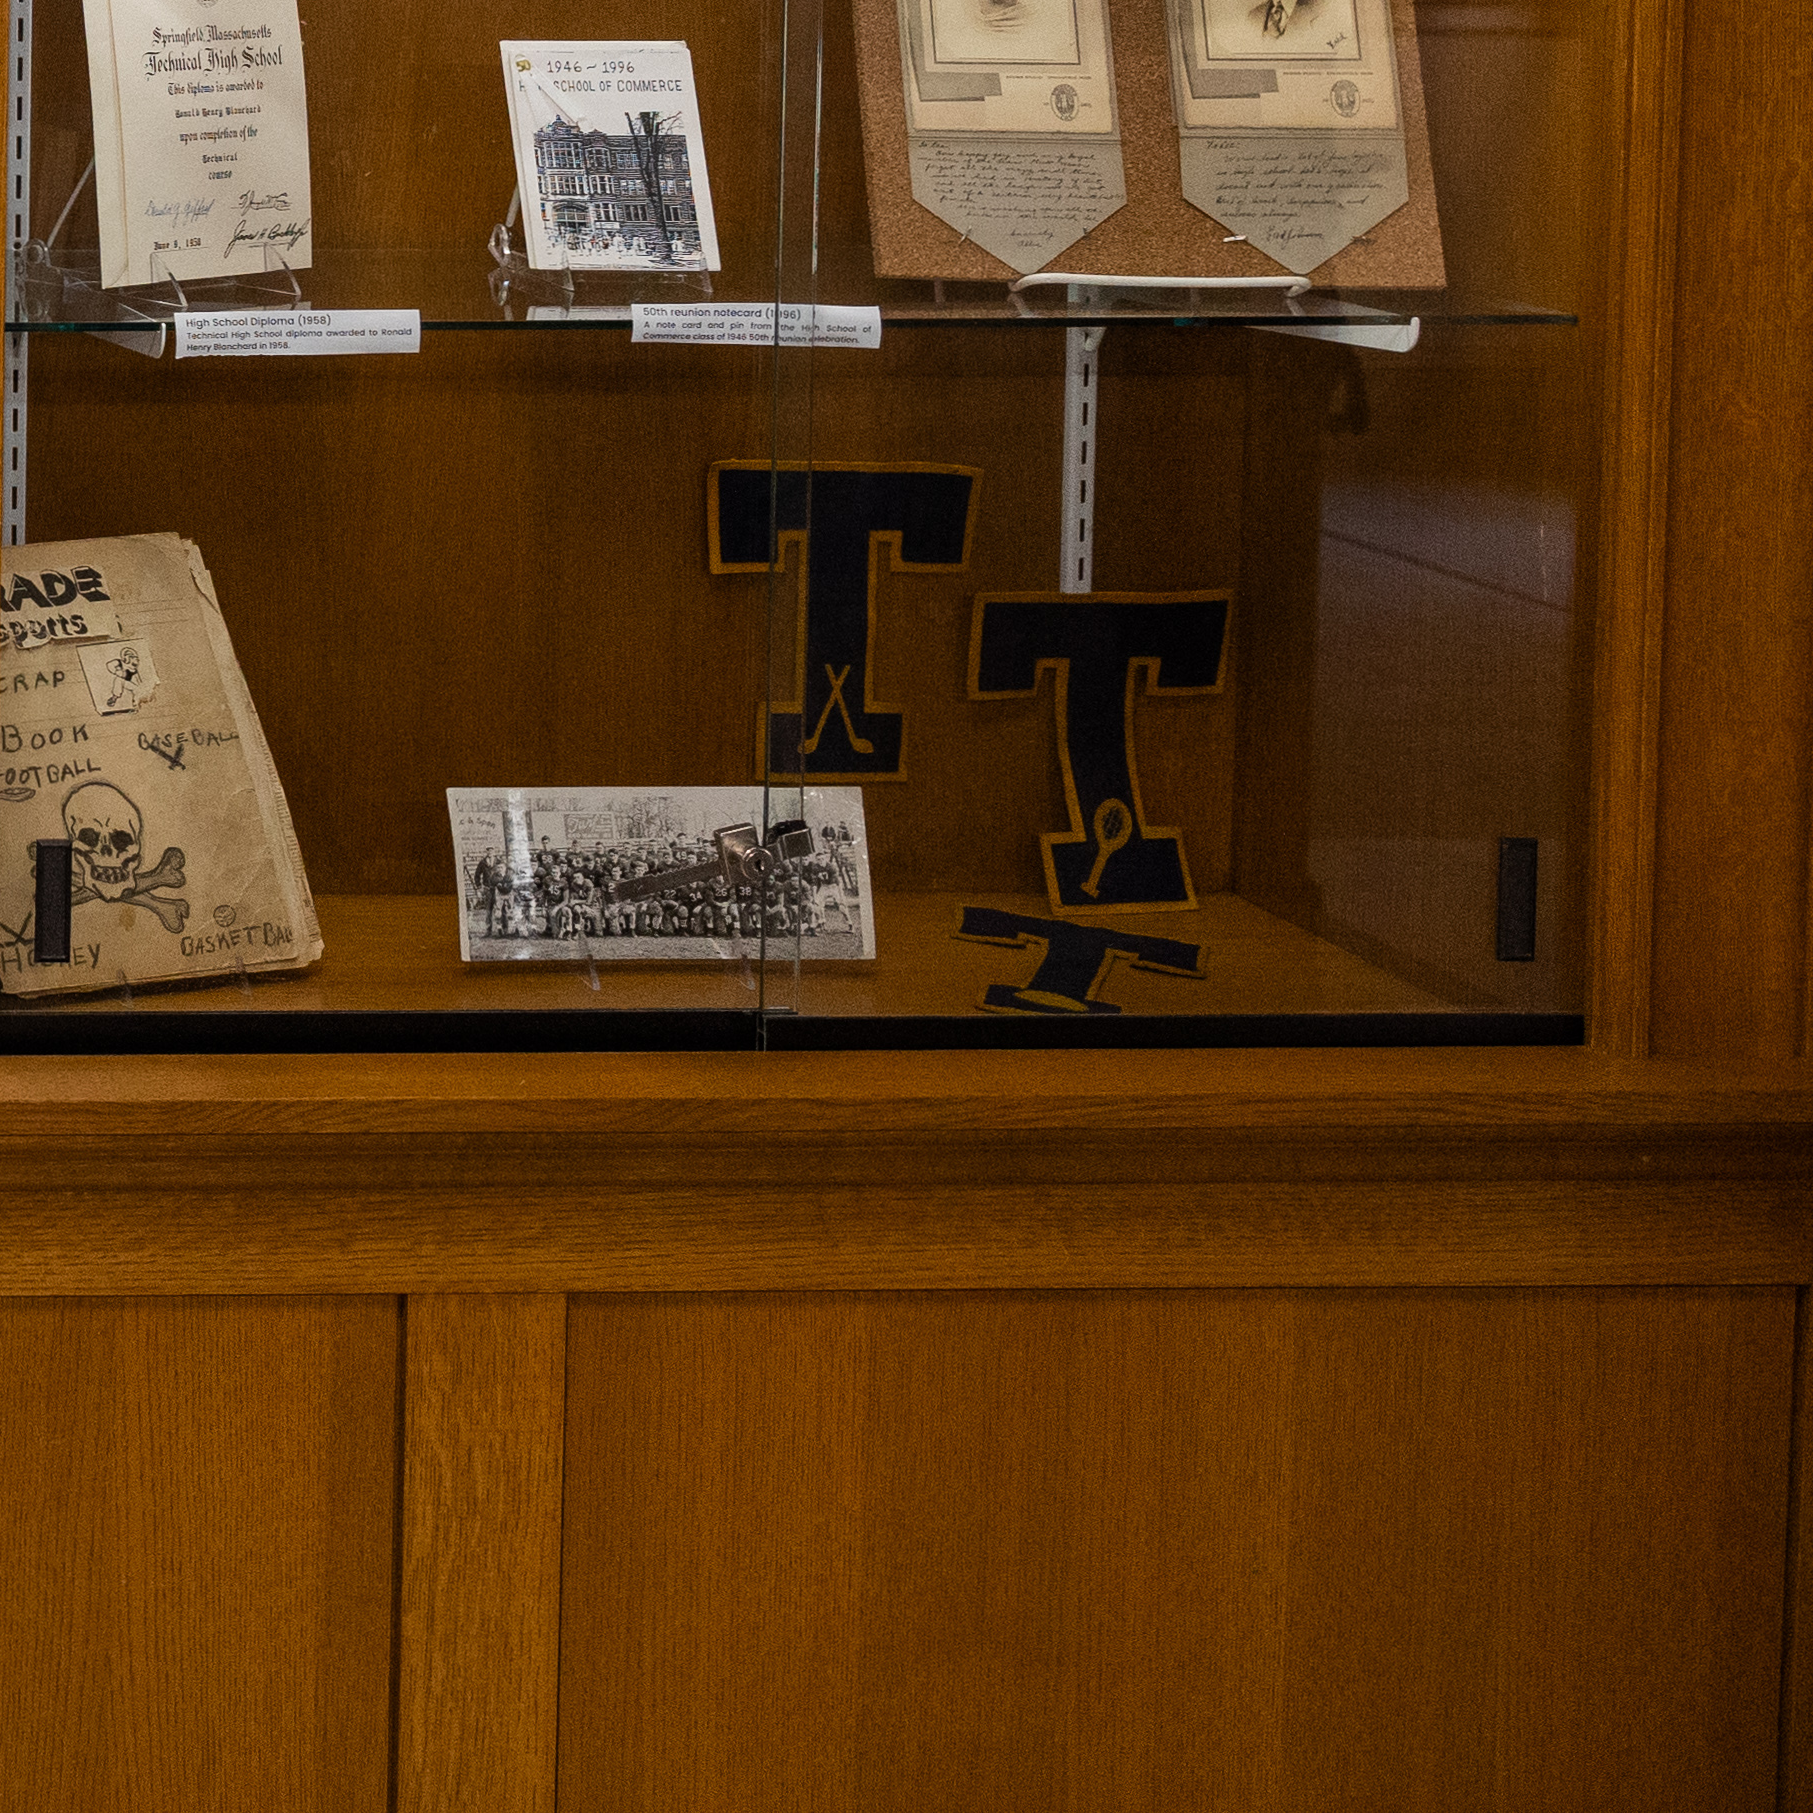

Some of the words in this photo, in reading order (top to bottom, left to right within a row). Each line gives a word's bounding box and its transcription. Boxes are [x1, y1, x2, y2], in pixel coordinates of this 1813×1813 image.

[142, 49, 202, 76] Technical
[203, 47, 239, 76] High
[241, 44, 283, 71] School
[547, 59, 582, 73] 1946
[601, 60, 635, 74] 1996
[553, 79, 596, 92] SCHOOL
[598, 79, 611, 92] OF
[616, 78, 682, 92] COMMERCE
[643, 306, 668, 316] 50th
[670, 306, 711, 317] reunion
[713, 308, 762, 318] notecard
[185, 318, 210, 329] High
[212, 316, 248, 327] School
[250, 316, 294, 329] Diploma
[298, 313, 331, 327] (1958)
[707, 460, 985, 783] T
[967, 589, 1234, 916] T
